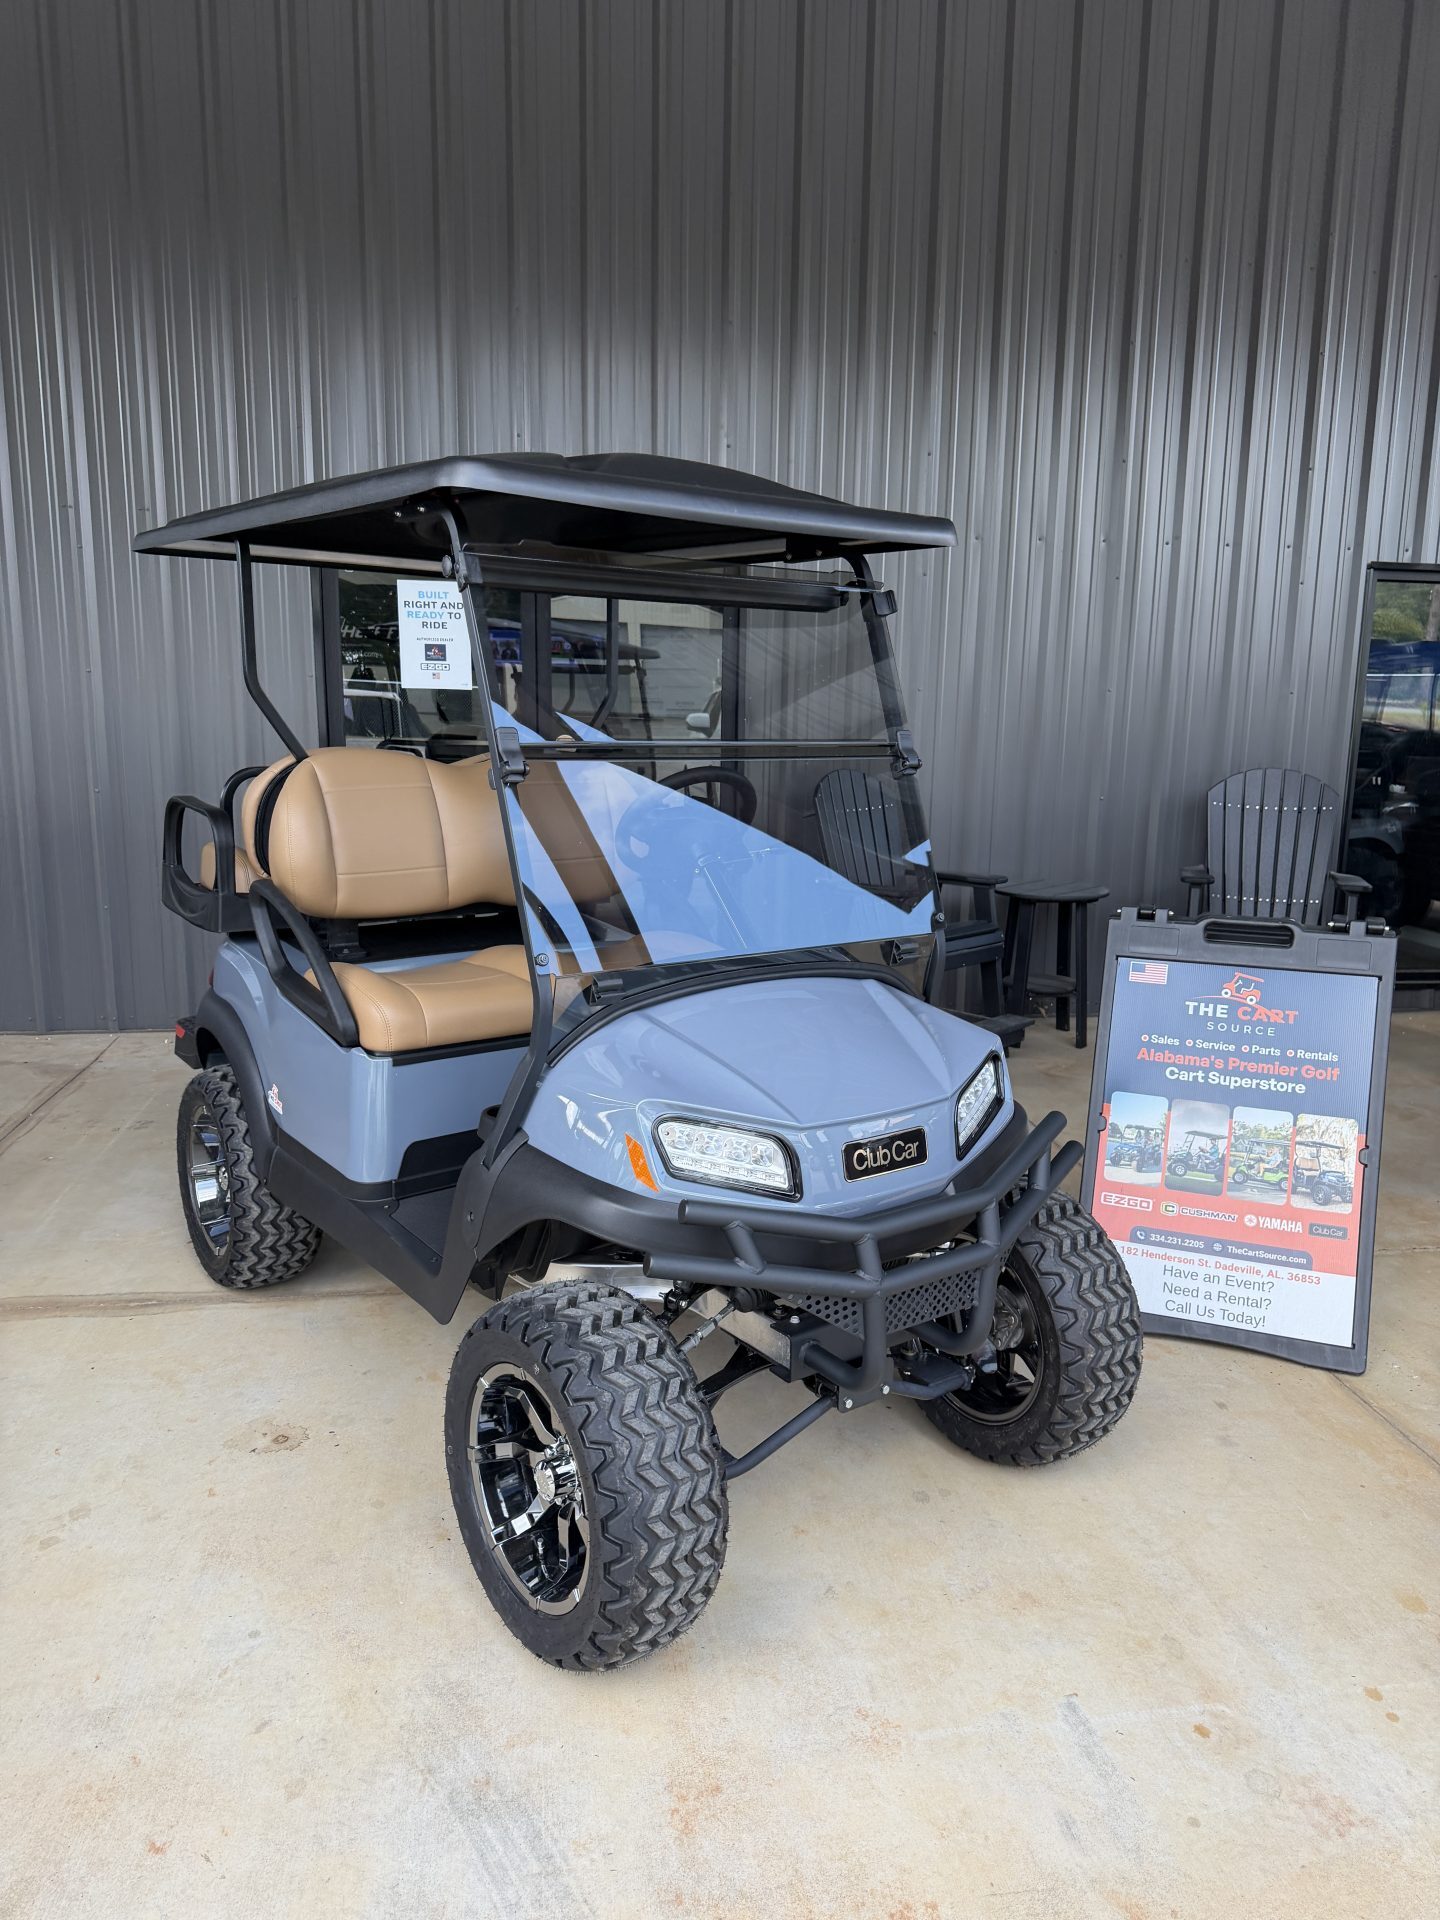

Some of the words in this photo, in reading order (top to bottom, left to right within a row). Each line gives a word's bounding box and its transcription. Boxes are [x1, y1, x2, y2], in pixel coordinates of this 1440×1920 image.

[404, 600, 437, 609] RIGHT
[440, 601, 464, 610] AND
[418, 591, 449, 599] BUILT
[407, 610, 445, 619] READY
[447, 612, 461, 620] TO
[422, 621, 448, 629] RIDE
[1185, 1001, 1228, 1018] THE
[1237, 1006, 1298, 1024] CART
[1207, 1021, 1276, 1036] SOURCE
[1151, 1034, 1180, 1046] Sales
[1195, 1039, 1236, 1051] Service
[1252, 1045, 1281, 1057] Parts
[1297, 1050, 1339, 1062] Rentals
[1136, 1047, 1224, 1069] Alabama's
[1228, 1057, 1298, 1077] Premier
[1301, 1064, 1340, 1081] Golf
[1165, 1066, 1205, 1084] Cart
[1207, 1070, 1306, 1094] Superstore
[853, 1145, 891, 1171] Club
[892, 1140, 919, 1161] Car
[1181, 1207, 1236, 1221] CUSHMAN
[1258, 1215, 1303, 1233] YAMAHA
[1312, 1225, 1329, 1235] Club
[1330, 1228, 1344, 1237] Car
[1149, 1233, 1205, 1249] 334.231.2205
[1226, 1245, 1307, 1264] TheCartSource.com
[1120, 1246, 1138, 1256] 182
[1141, 1249, 1195, 1265] Henderson
[1199, 1258, 1211, 1268] St.
[1215, 1261, 1264, 1278] Dadeville,
[1267, 1269, 1284, 1280] AL.
[1287, 1272, 1321, 1285] 36853
[1163, 1264, 1198, 1281] Have
[1203, 1273, 1220, 1285] an
[1225, 1275, 1275, 1293] Event?
[1163, 1282, 1199, 1298] Need
[1203, 1291, 1212, 1301] a
[1217, 1291, 1272, 1310] Rental?
[1165, 1300, 1192, 1315] Call
[1196, 1304, 1215, 1319] Us
[1219, 1308, 1266, 1328] Today!
